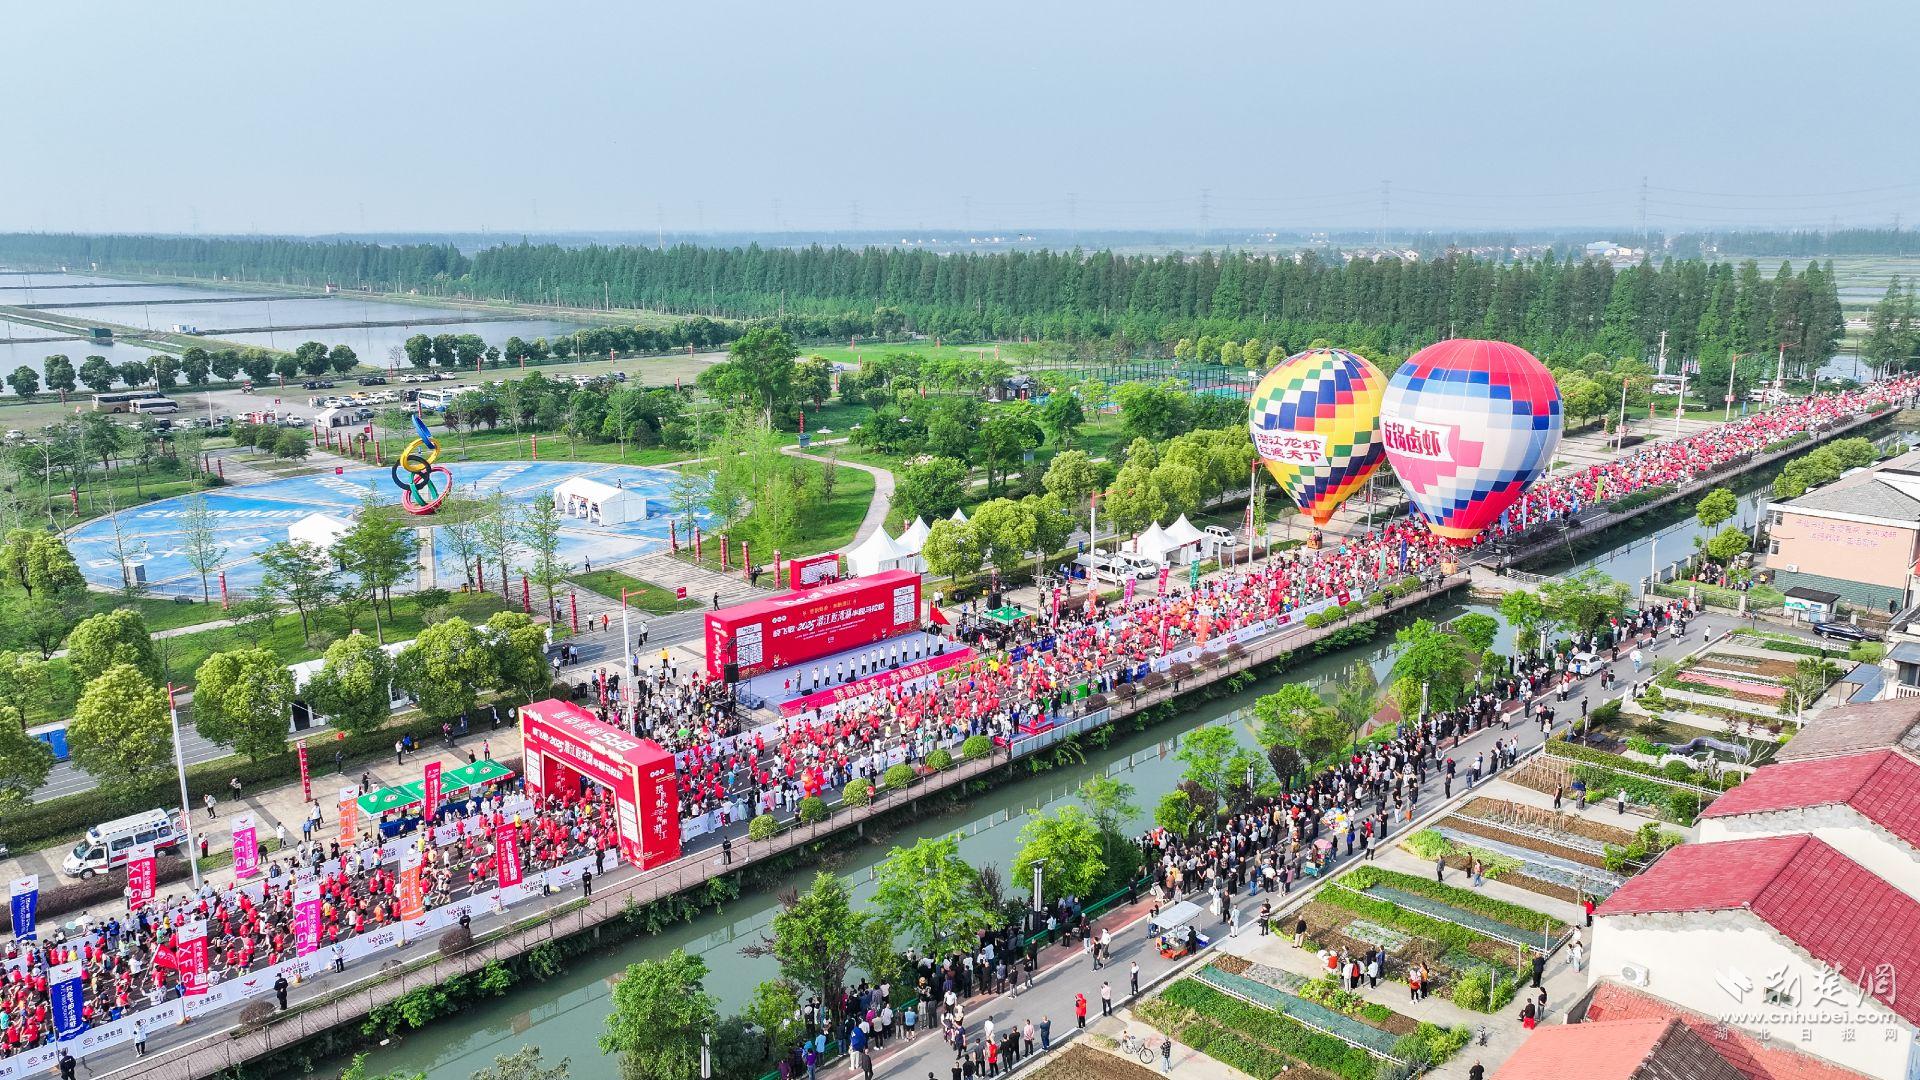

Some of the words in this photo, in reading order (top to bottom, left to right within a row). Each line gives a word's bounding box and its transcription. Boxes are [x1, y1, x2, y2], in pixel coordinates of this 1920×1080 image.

[1257, 433, 1322, 451] 潜江龙虾
[1258, 445, 1322, 462] 红遍天下
